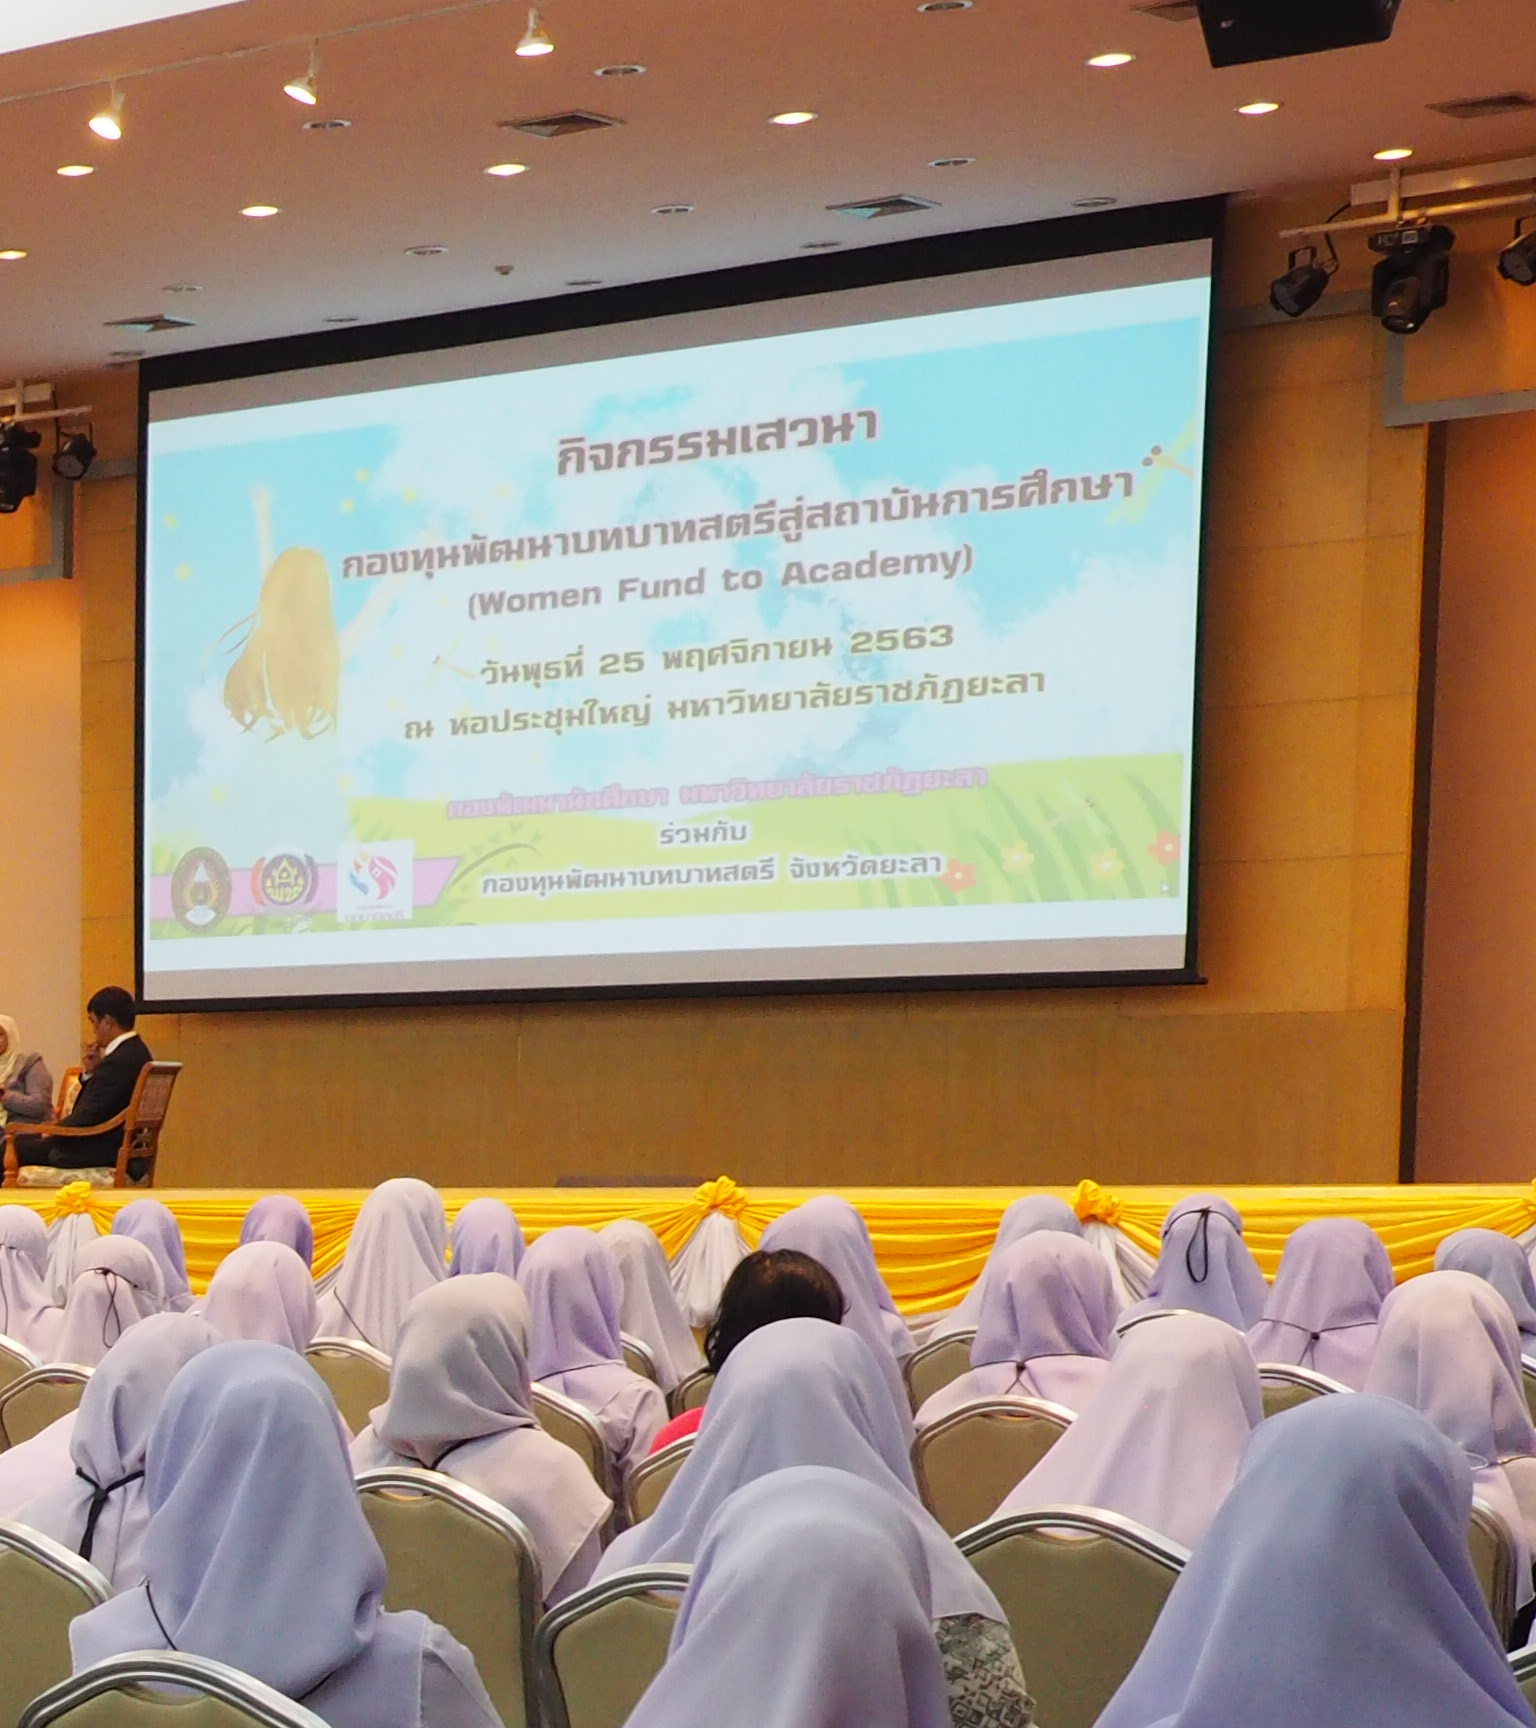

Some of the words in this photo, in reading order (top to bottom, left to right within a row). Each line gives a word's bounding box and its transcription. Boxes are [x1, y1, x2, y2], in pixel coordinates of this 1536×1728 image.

[557, 409, 878, 476] กิจกรรมเสวนา
[468, 585, 602, 620] (Women
[617, 567, 706, 602] Fund
[721, 569, 763, 593] to
[780, 543, 974, 587] Academy)
[480, 644, 585, 689] วันพุธที่
[598, 651, 645, 676] 25
[661, 636, 833, 673] พฤศจิกายน
[849, 624, 954, 655] 2563
[404, 719, 435, 740] ณ
[449, 694, 652, 736] หอประชุมใหญ่
[659, 820, 748, 845] ร่วมกับ
